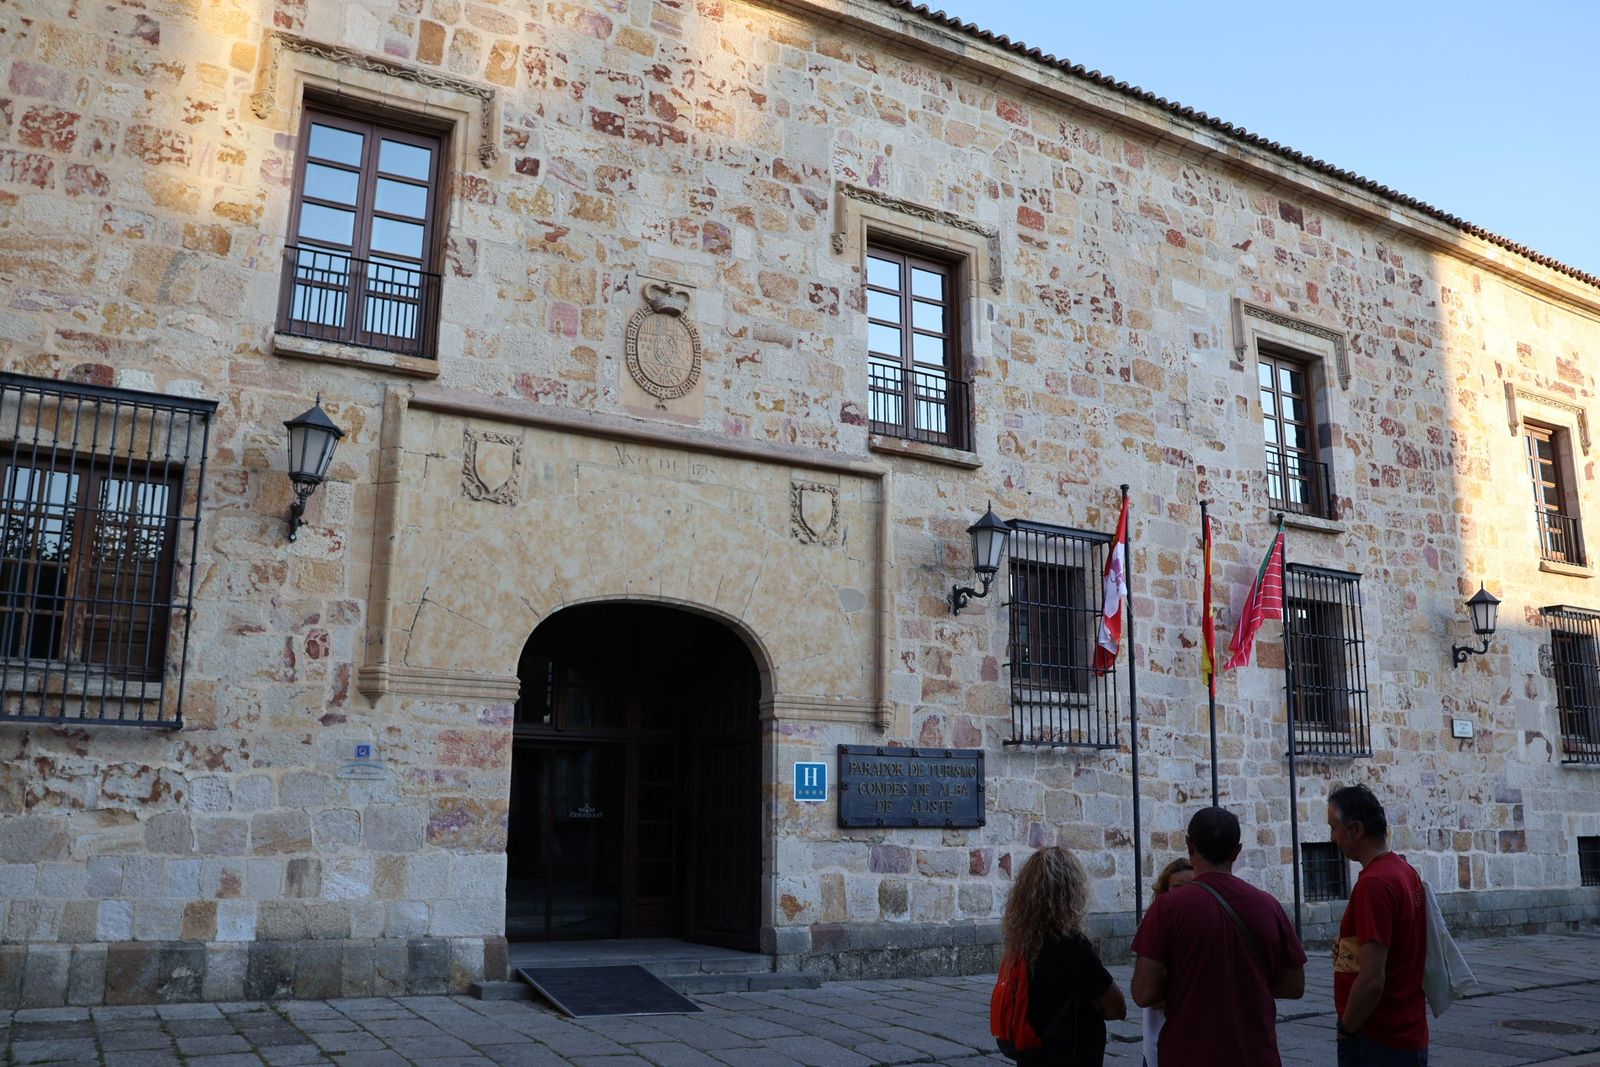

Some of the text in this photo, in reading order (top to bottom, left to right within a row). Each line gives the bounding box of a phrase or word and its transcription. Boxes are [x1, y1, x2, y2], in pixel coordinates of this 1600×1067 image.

[803, 767, 818, 787] H
[848, 761, 977, 778] PARADOR DE TURISMO
[859, 782, 970, 797] CONDES DE ALBA
[876, 801, 953, 814] DE ALISTE
